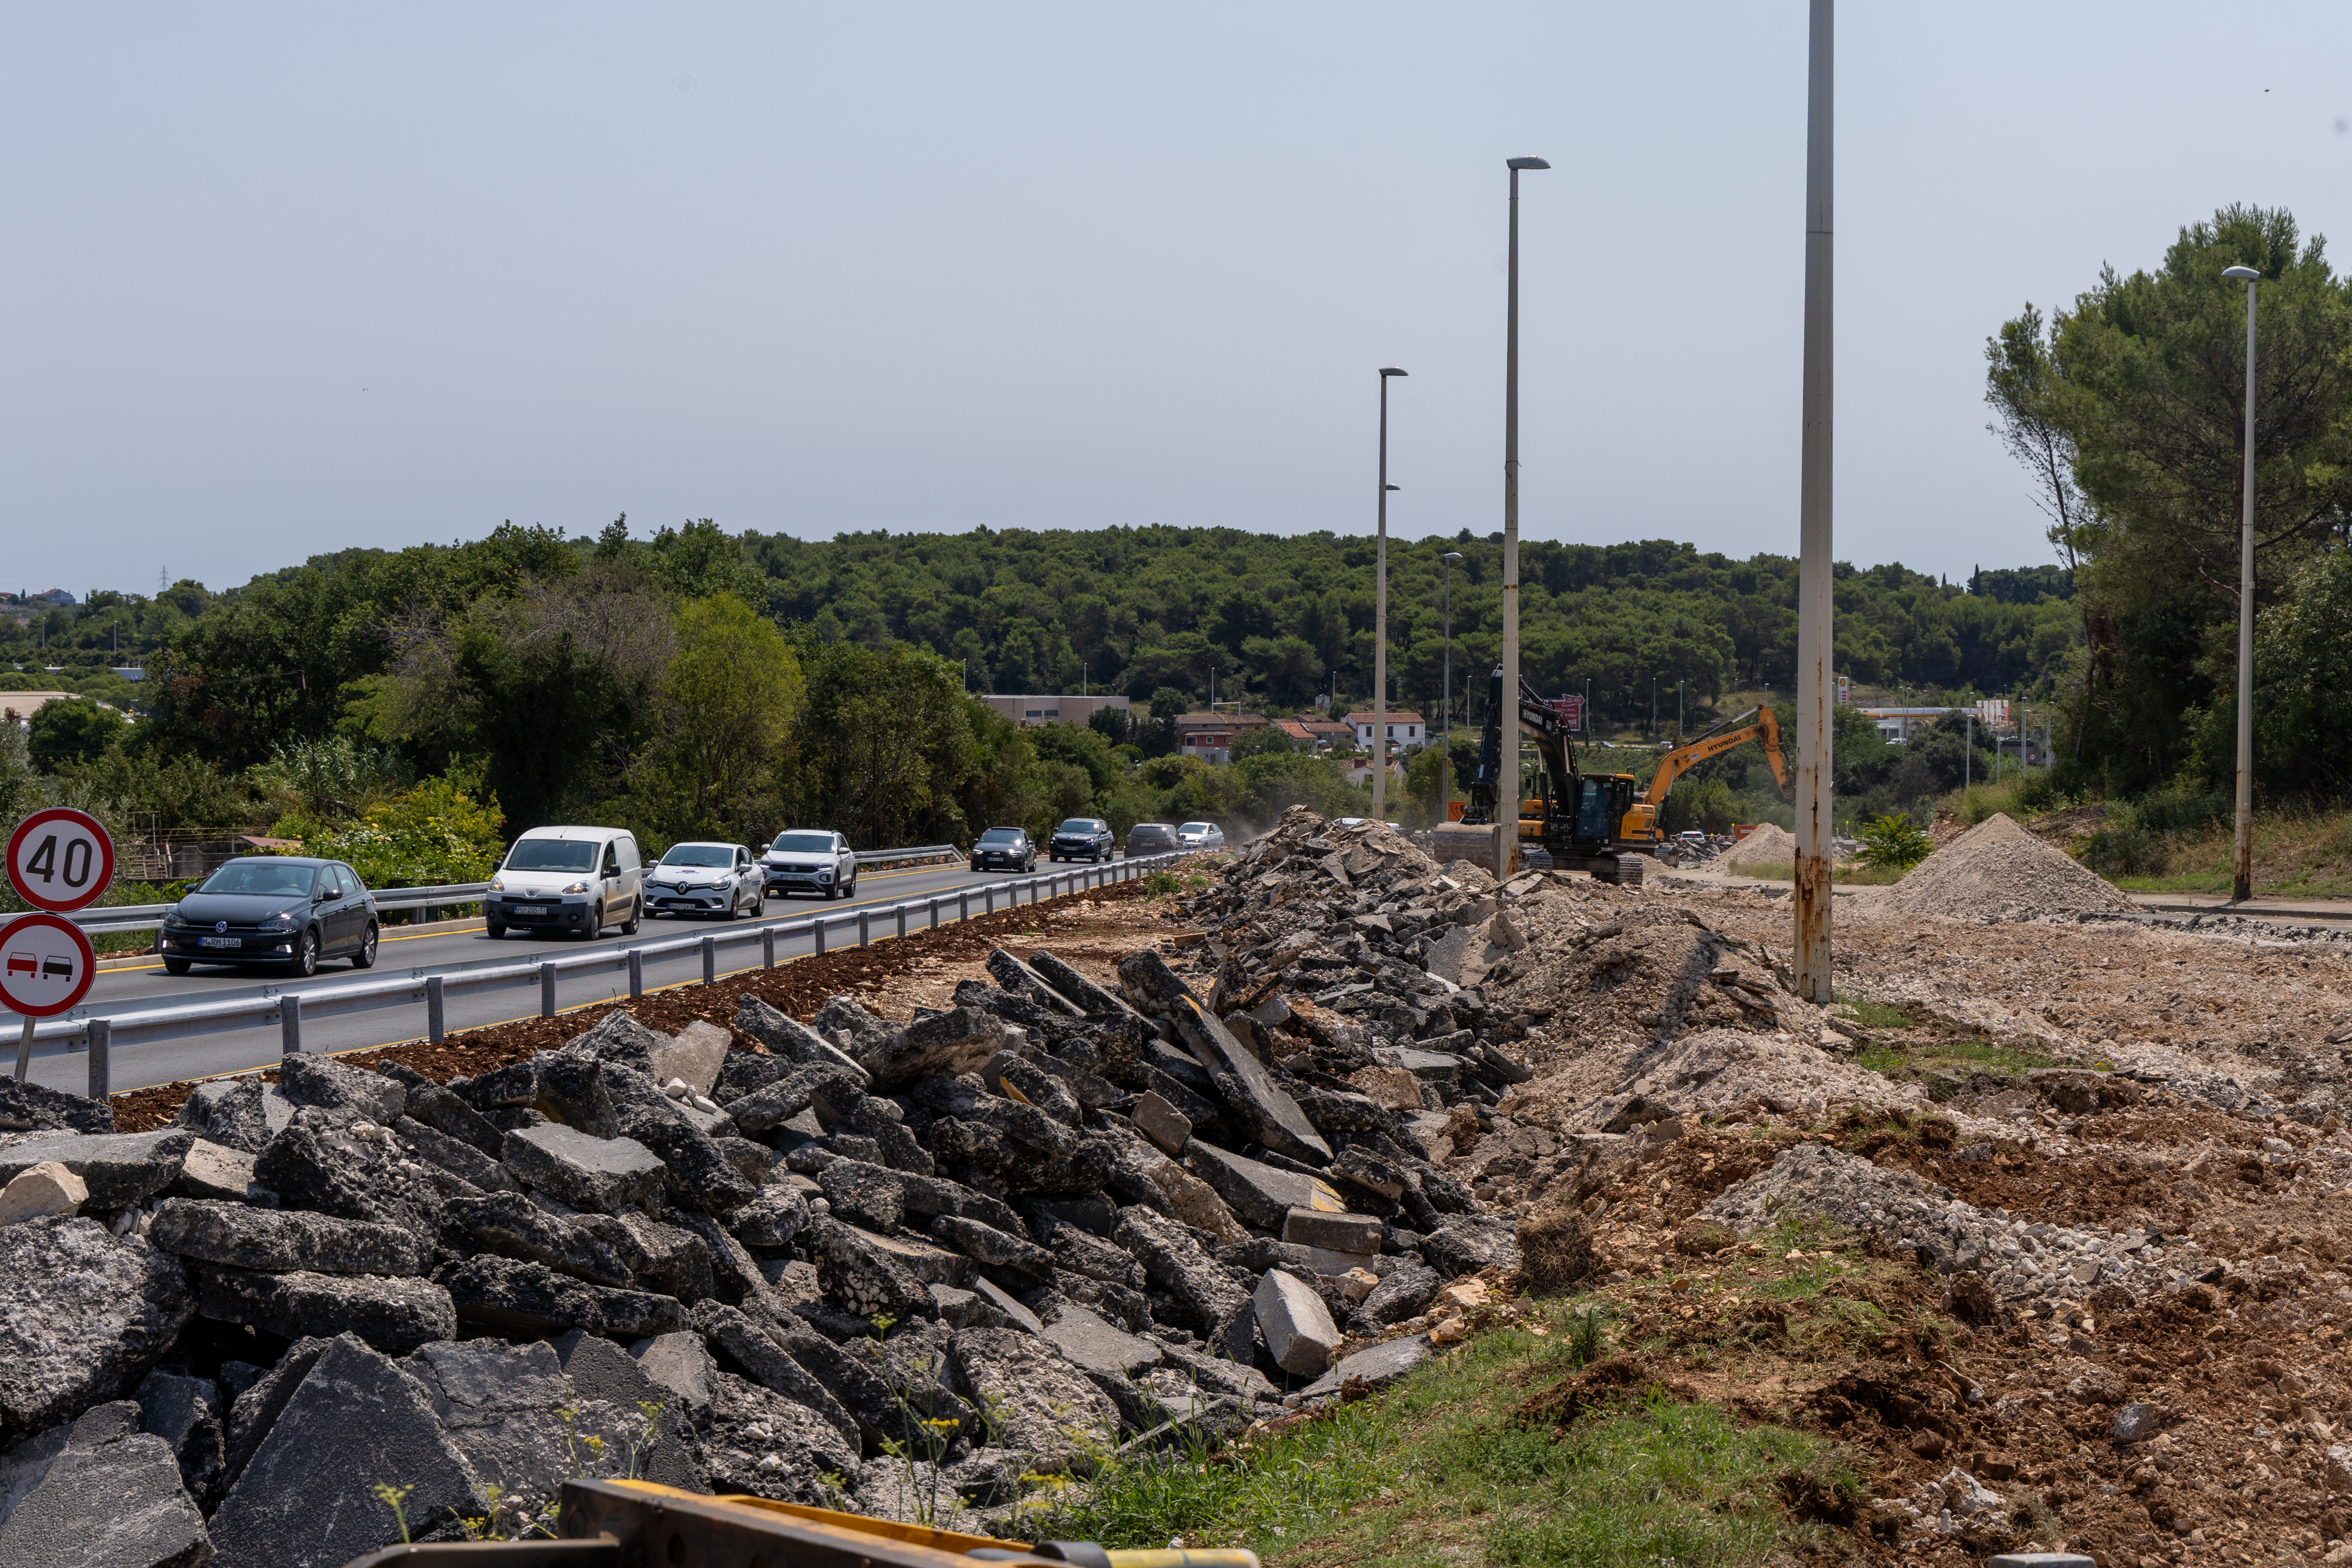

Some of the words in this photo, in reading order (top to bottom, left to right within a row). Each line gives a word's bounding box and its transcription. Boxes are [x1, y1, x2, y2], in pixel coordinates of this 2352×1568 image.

[1524, 709, 1543, 725] HYUNDAI
[1708, 735, 1741, 752] HYUNDAI
[26, 835, 92, 888] 40
